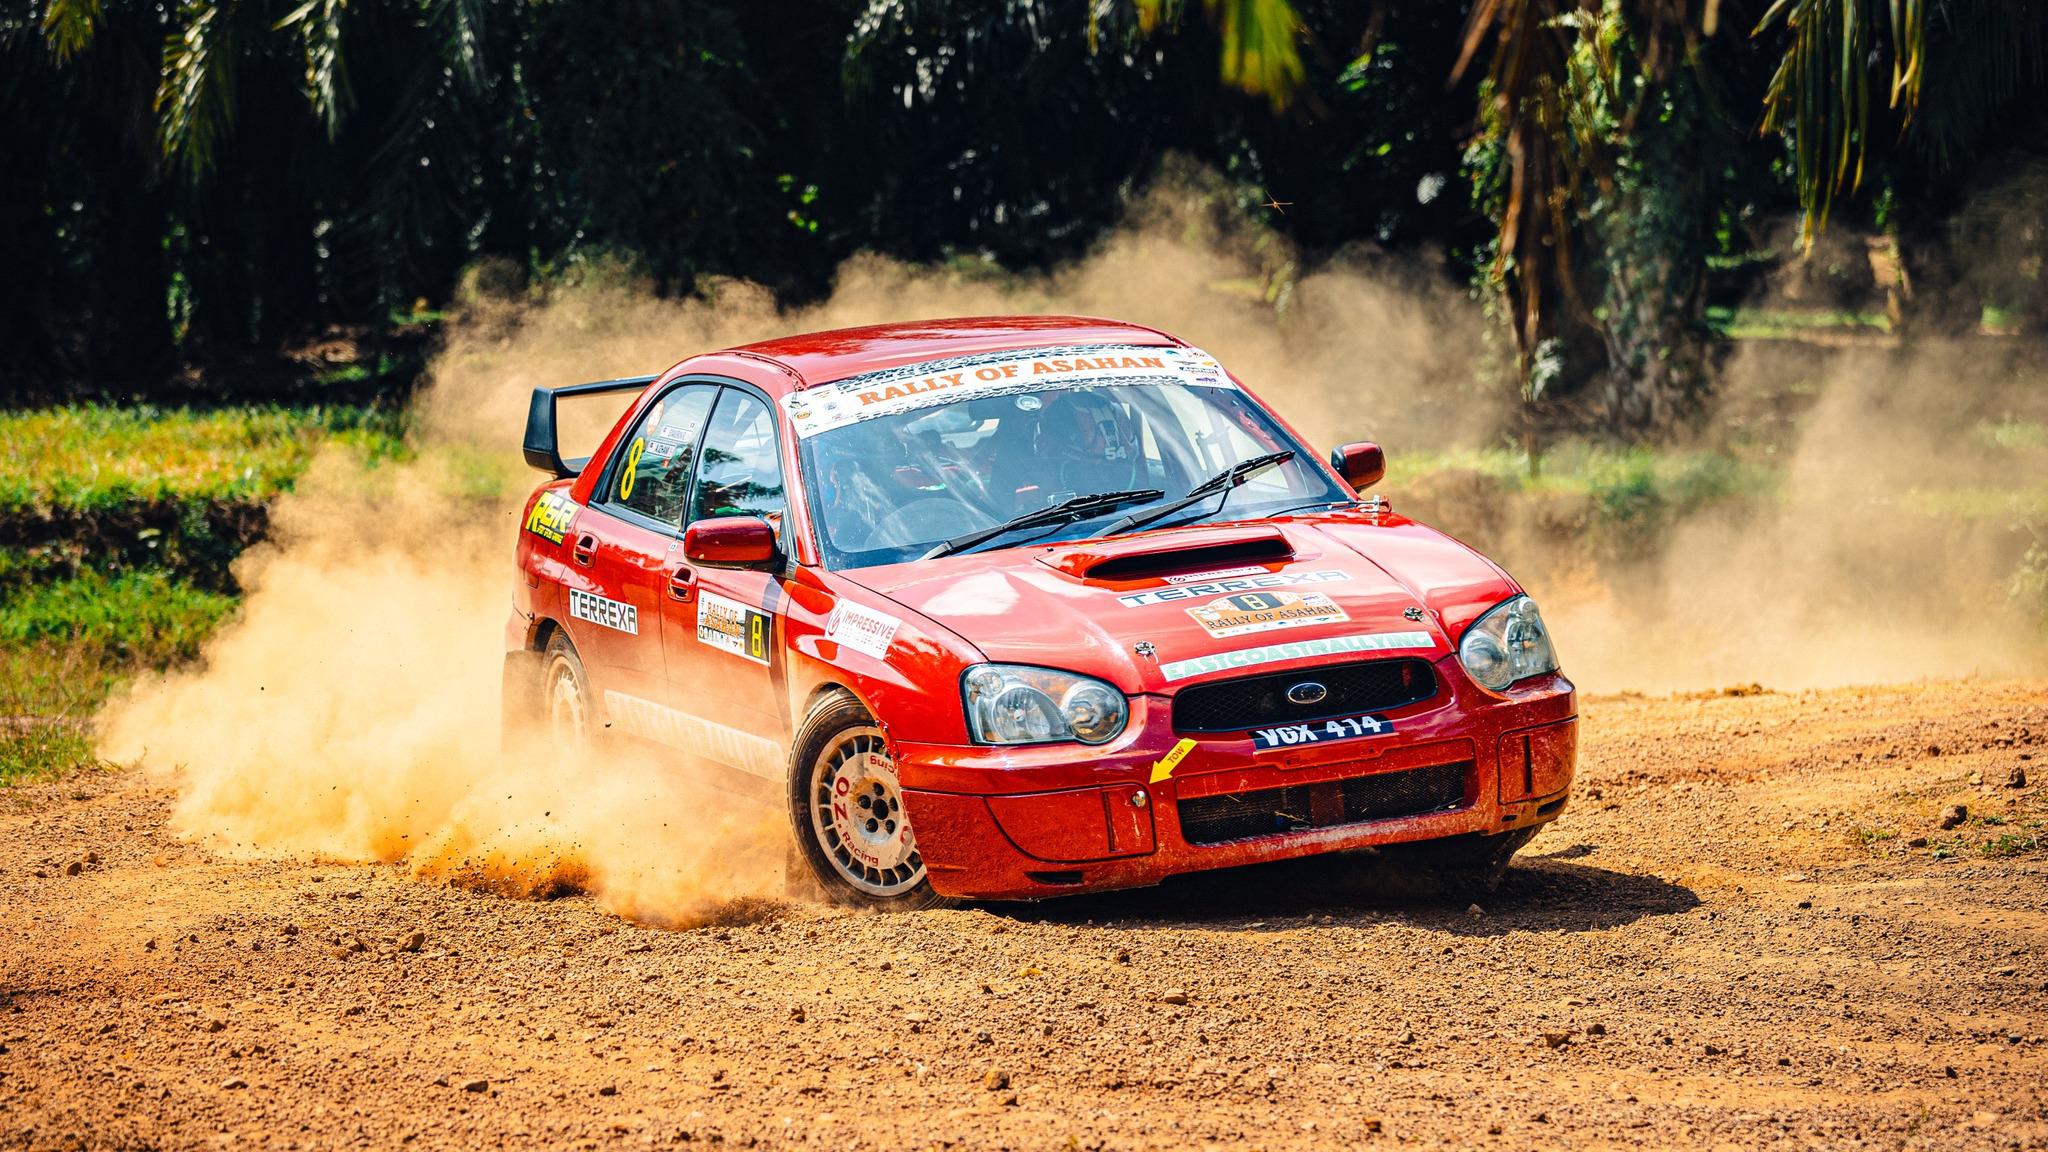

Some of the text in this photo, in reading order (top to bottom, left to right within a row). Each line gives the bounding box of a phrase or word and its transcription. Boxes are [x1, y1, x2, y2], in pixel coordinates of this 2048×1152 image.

[857, 372, 964, 406] RALLY
[975, 364, 1018, 381] OF
[1033, 357, 1165, 375] ASAHAN
[621, 437, 645, 501] 8
[1121, 571, 1350, 605] TERREXA
[1239, 594, 1270, 610] 8
[571, 590, 637, 633] TERREXA
[842, 610, 894, 640] IMPRESSIVE
[1206, 605, 1337, 629] RALLY OF ASAHAN
[751, 615, 763, 657] 8
[1166, 632, 1433, 680] EASTCOASTRALLYING
[1256, 715, 1382, 747] VGX 414
[1167, 746, 1185, 763] TOW
[843, 832, 879, 866] Racing
